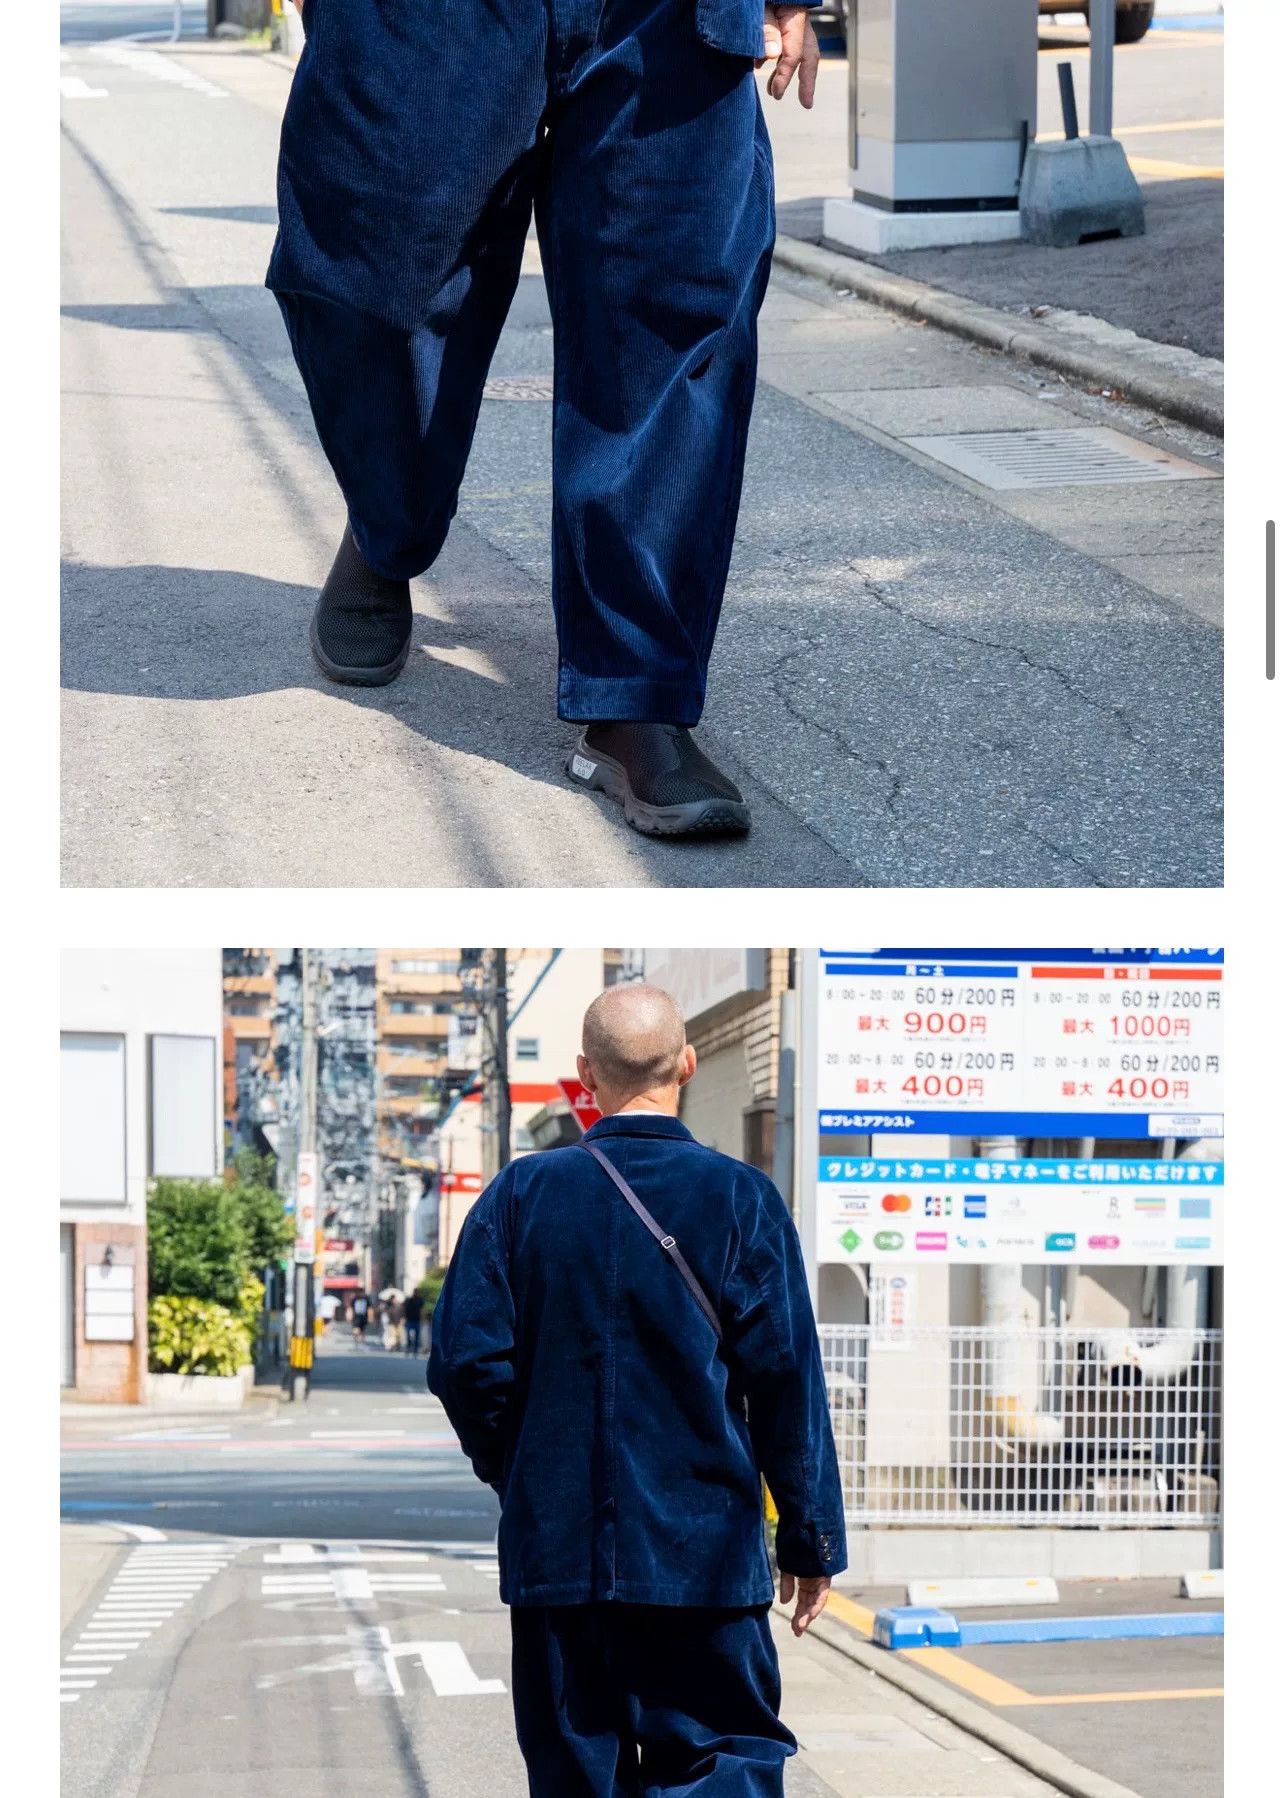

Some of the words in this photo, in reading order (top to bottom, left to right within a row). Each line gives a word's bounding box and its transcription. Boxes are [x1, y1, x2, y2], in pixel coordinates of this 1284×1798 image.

[904, 1012, 986, 1035] 900円
[1111, 1016, 1190, 1037] 1000円
[902, 1075, 984, 1097] 400円
[1107, 1078, 1190, 1100] 400円
